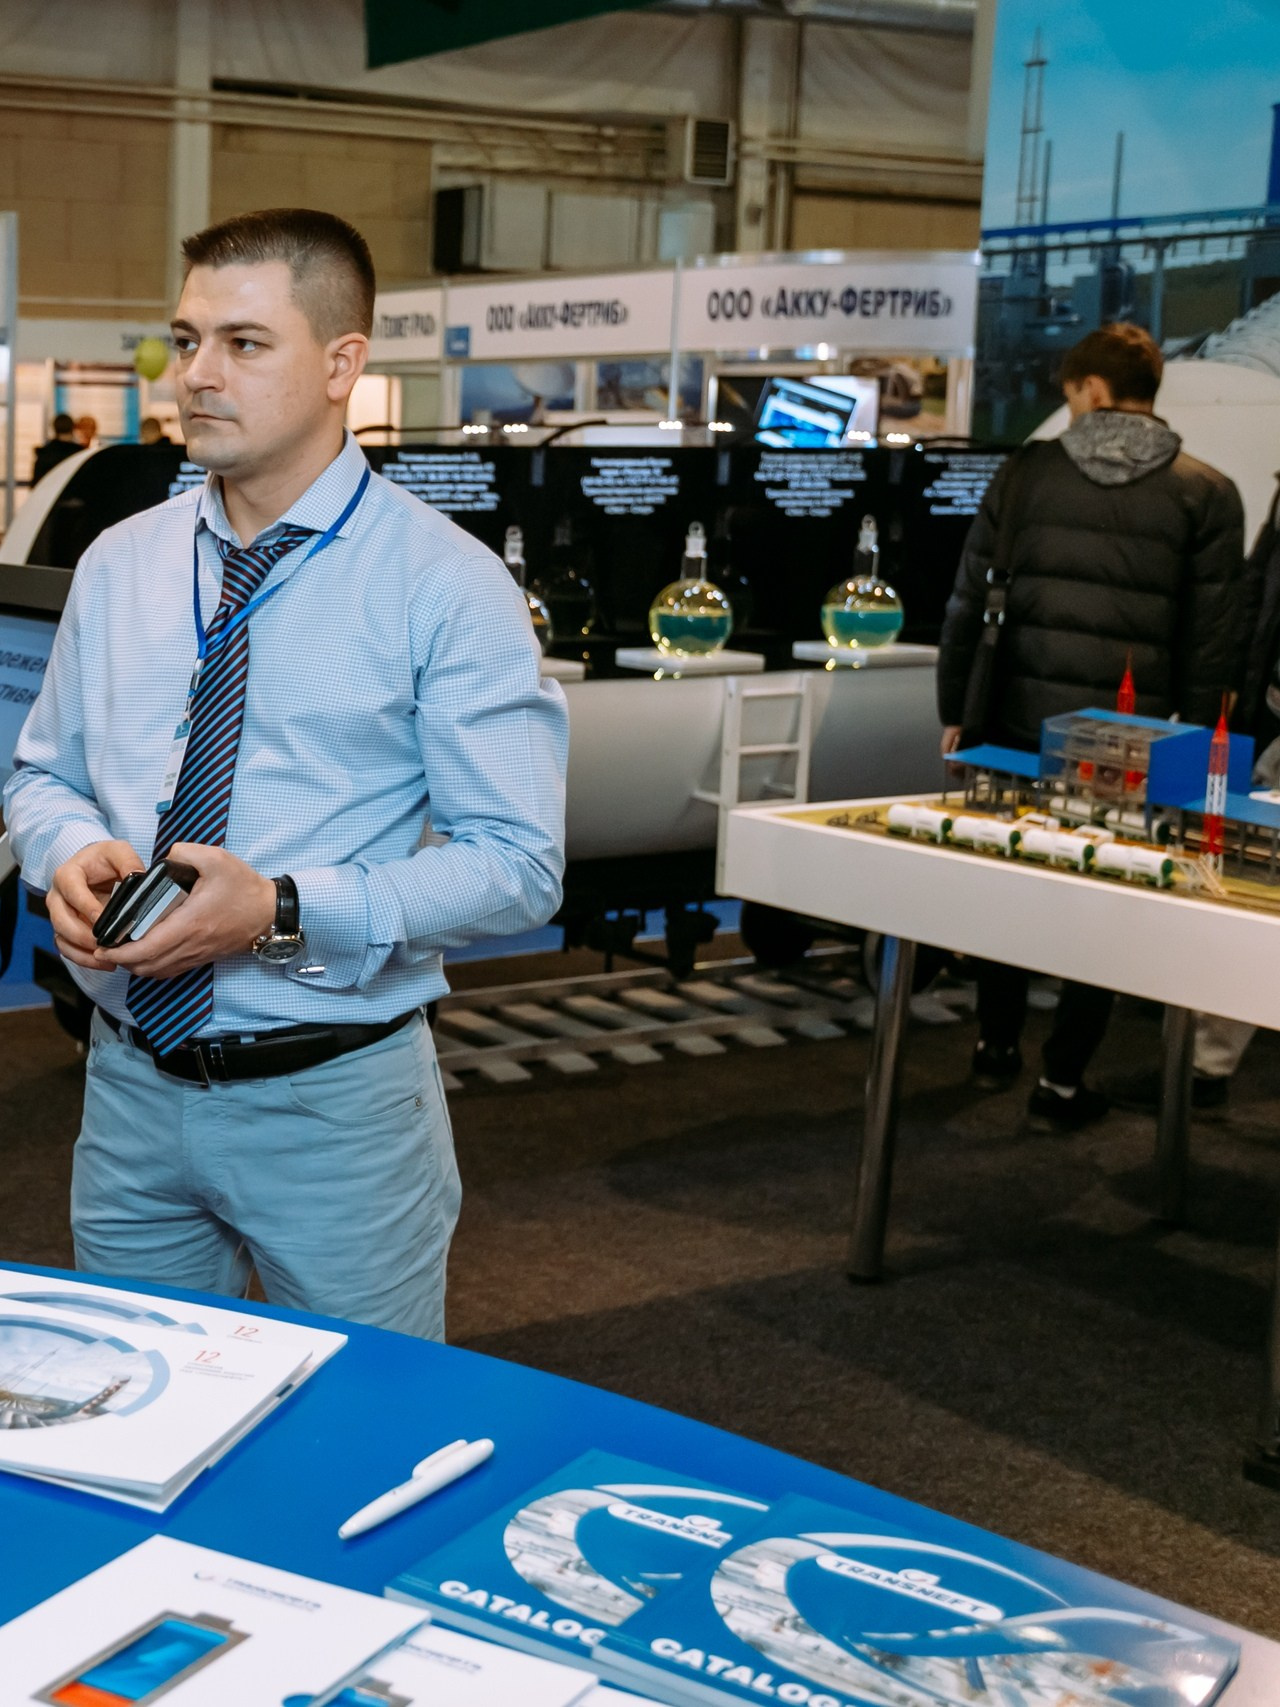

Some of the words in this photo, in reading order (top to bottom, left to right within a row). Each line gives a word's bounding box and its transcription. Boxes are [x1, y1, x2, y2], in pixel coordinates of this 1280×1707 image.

[707, 288, 753, 321] ООО
[195, 1350, 221, 1364] 12
[833, 1561, 980, 1613] TRANSNEFT
[650, 1638, 857, 1707] CATALOG
